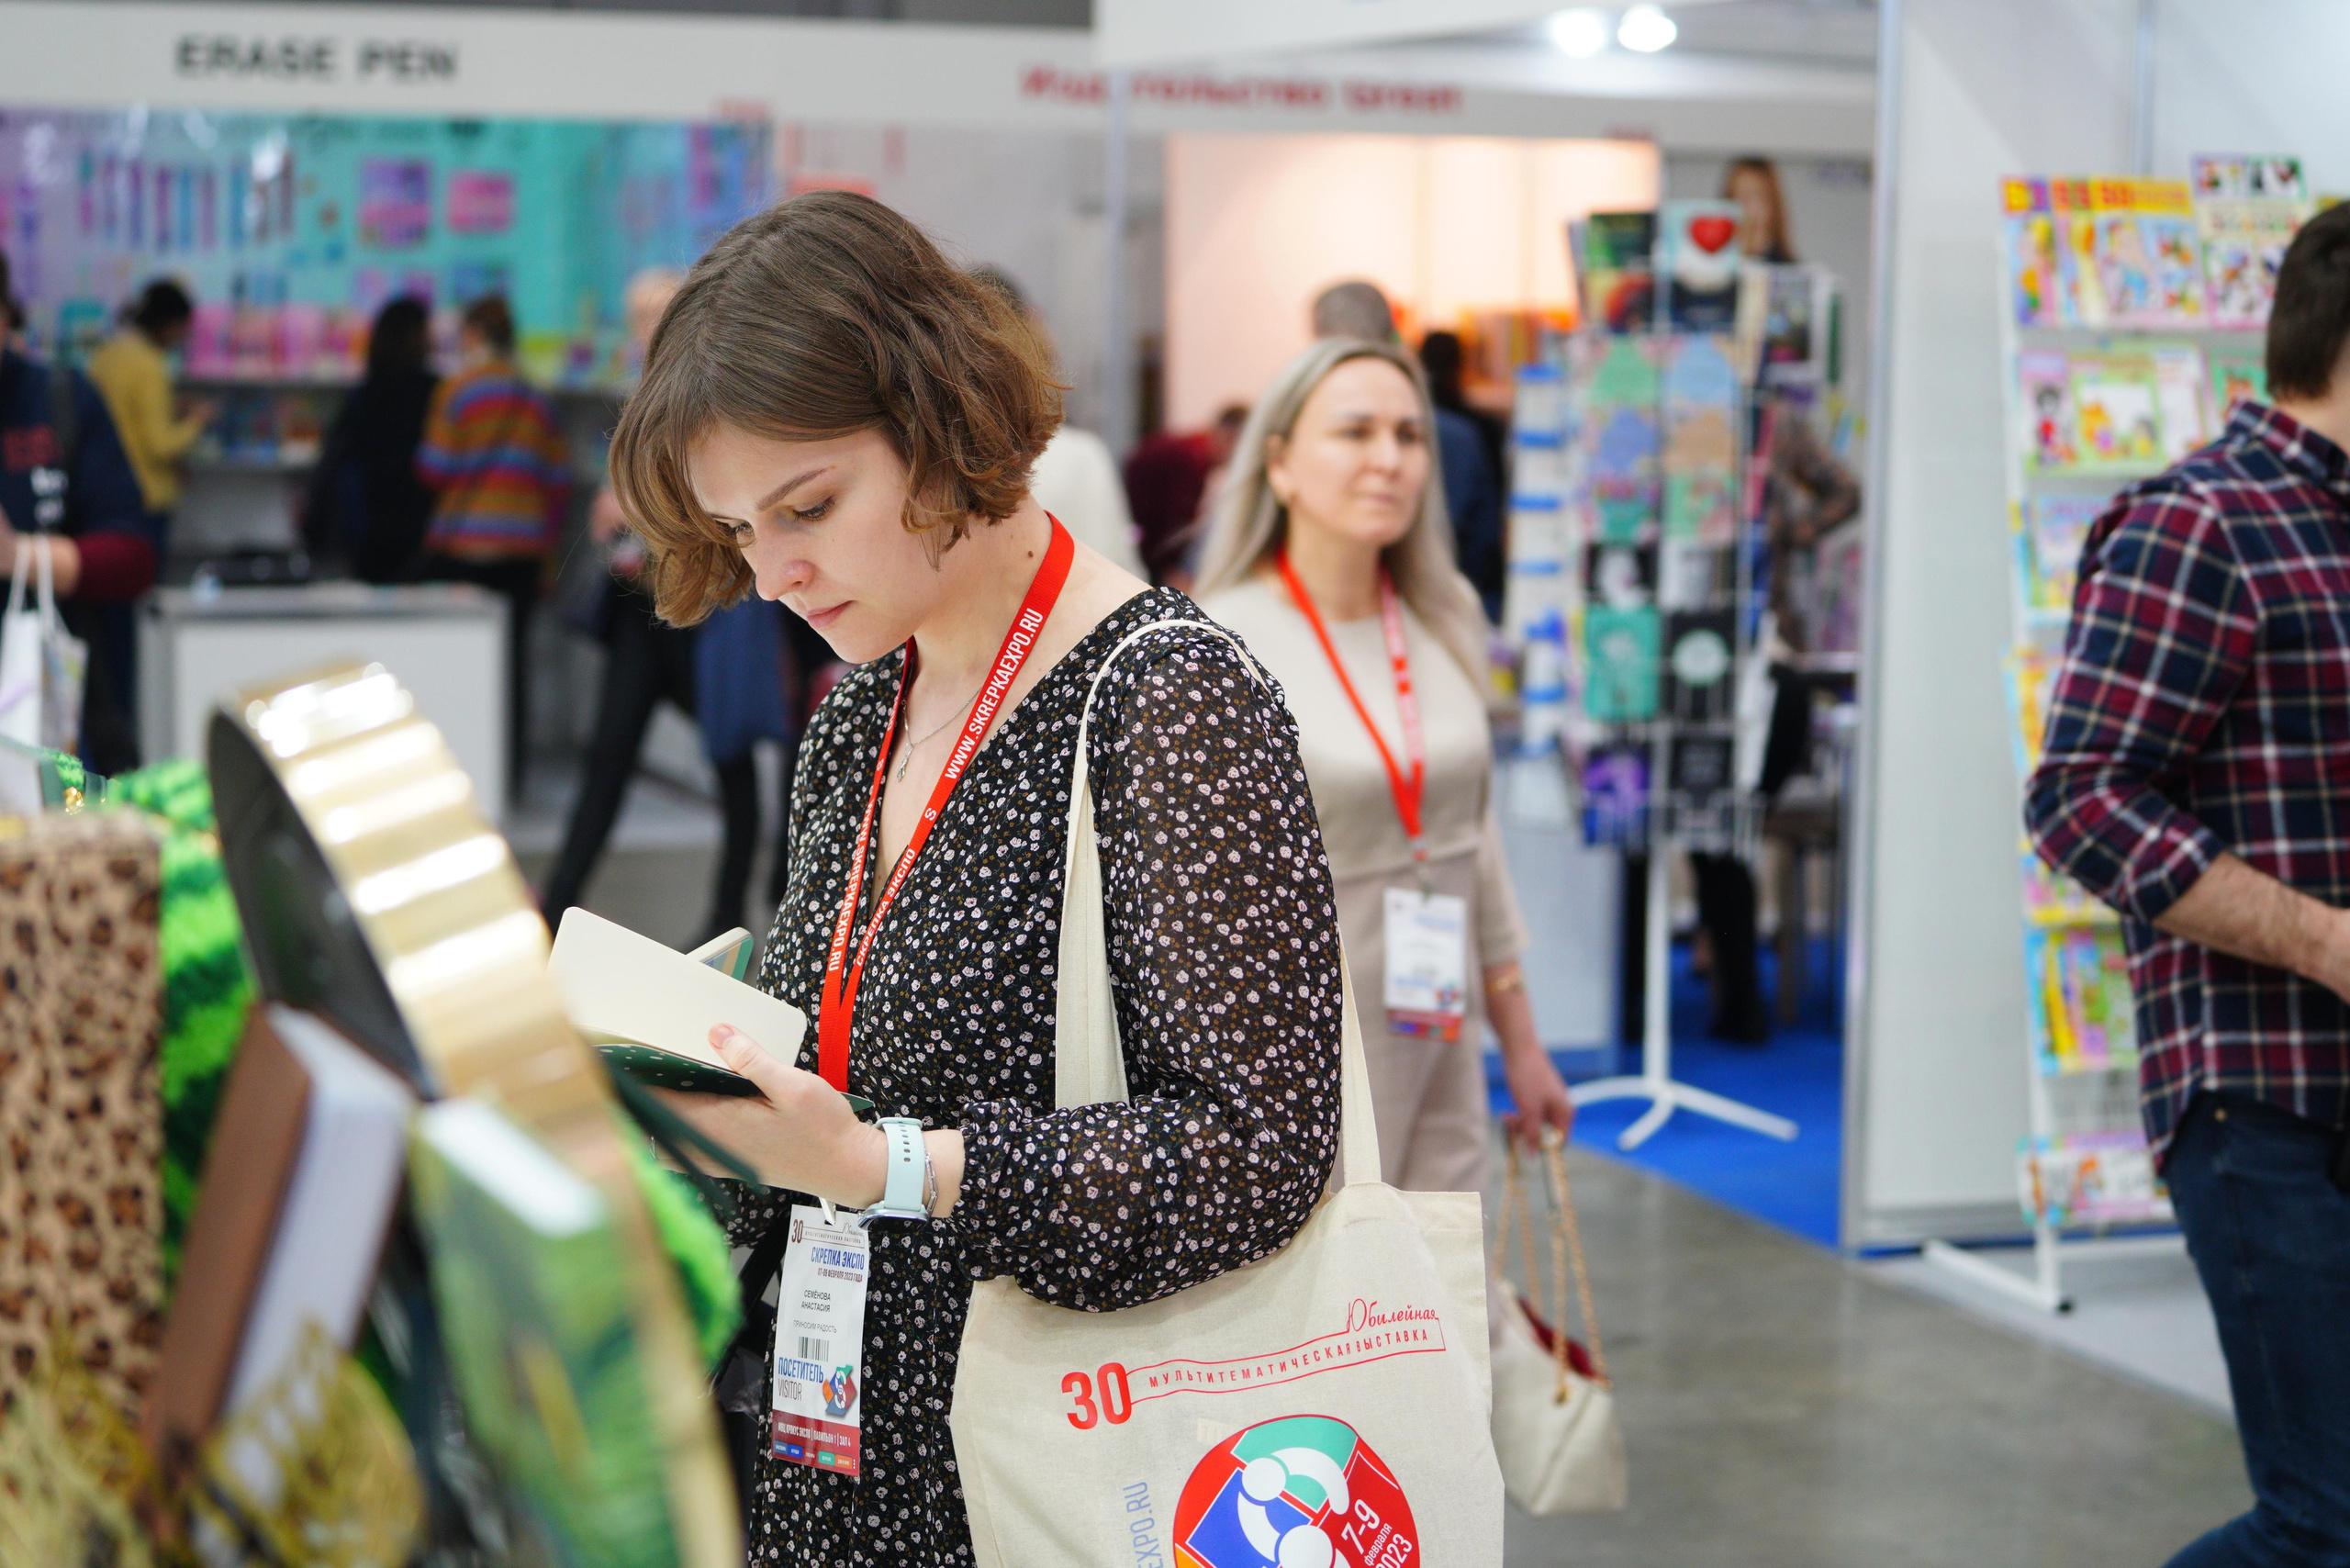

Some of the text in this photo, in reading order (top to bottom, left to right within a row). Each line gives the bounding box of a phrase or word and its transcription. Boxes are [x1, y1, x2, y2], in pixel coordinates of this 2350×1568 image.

[174, 37, 458, 83] ERASE PEN
[945, 607, 1043, 779] WWW.SKREPKAEXPO.RU
[829, 798, 874, 972] WWW.SKREPKAEXPO.RU
[856, 848, 915, 967] СКРЕПКА ЭКСПО
[791, 1219, 803, 1243] 30
[811, 1247, 865, 1270] СКРЕПКА ЭКСПО
[828, 1270, 844, 1280] ФЕВРАЛЯ
[844, 1271, 853, 1282] 2023
[853, 1273, 863, 1282] ГОДА
[800, 1301, 831, 1313] АНАСТАСИЯ
[803, 1289, 831, 1301] СЕМЁНОВА
[792, 1319, 837, 1334] ПРИНОСИМ РАДОСТЬ
[1347, 1298, 1438, 1332] Юбилейная
[778, 1357, 824, 1383] ПОСЕТИТЕЛЬ
[1061, 1328, 1428, 1429] 30 МУЛЬТИТЕМАТИЧЕСКАЯ ВЫСТАВКА
[778, 1378, 802, 1401] VISITOR
[799, 1427, 811, 1439] ЭКСПО
[813, 1430, 834, 1444] ПАВИЛЬОН
[839, 1435, 848, 1447] ЗАЛ
[1341, 1499, 1380, 1555] 7-9
[1364, 1523, 1393, 1566] февраля
[1375, 1534, 1412, 1568] 023
